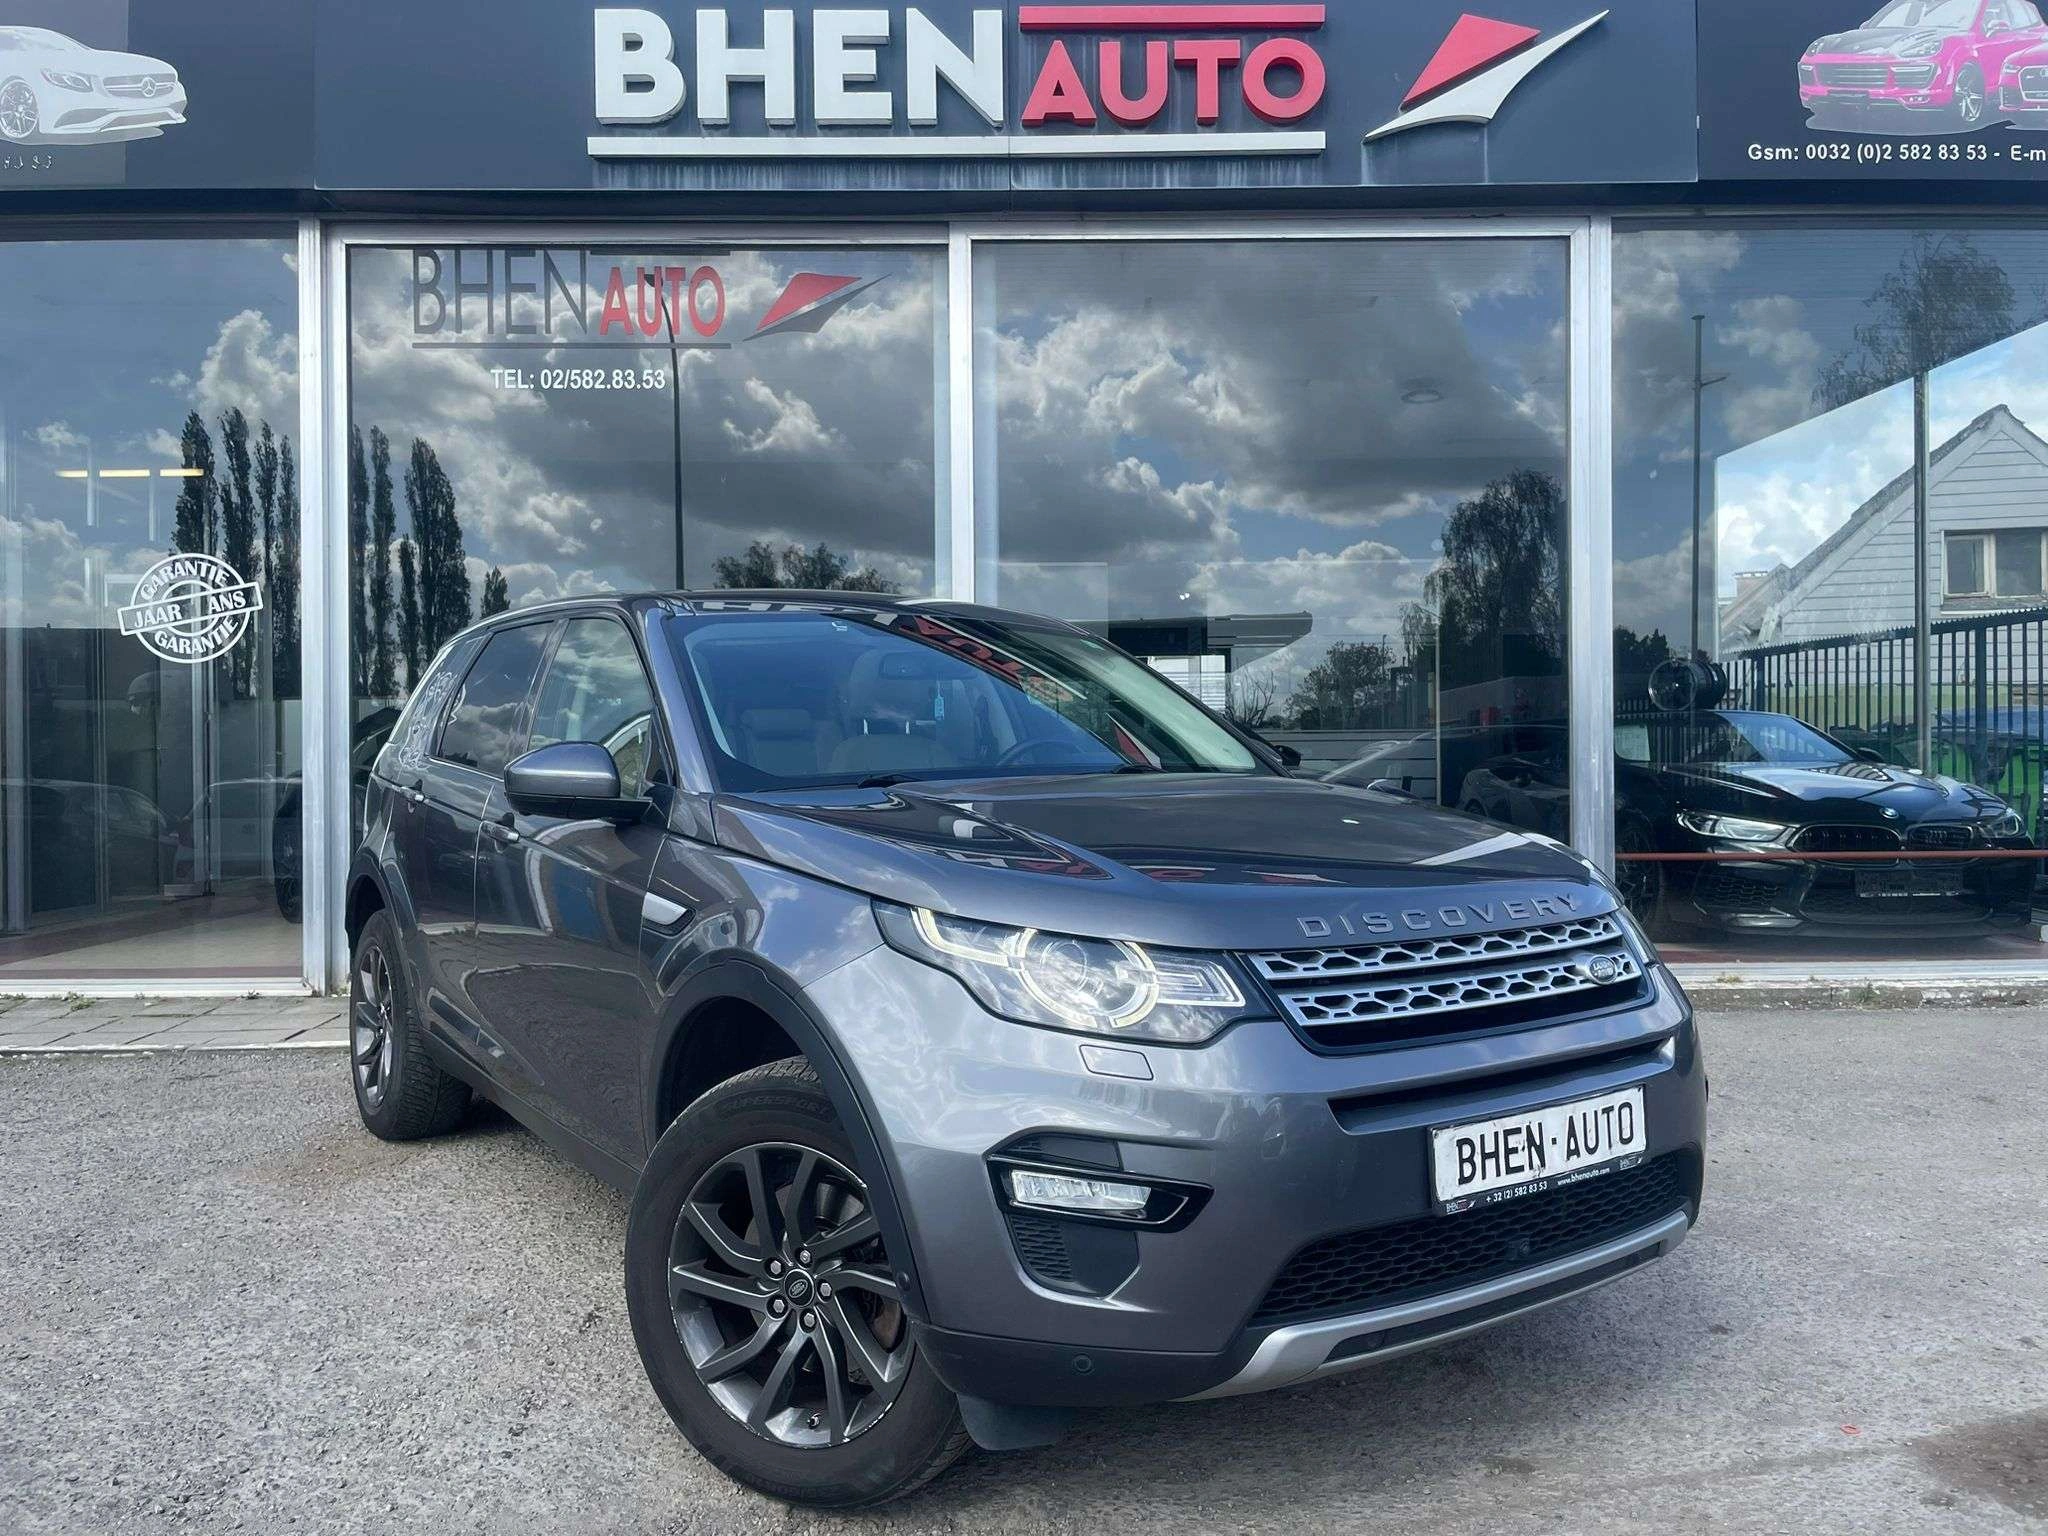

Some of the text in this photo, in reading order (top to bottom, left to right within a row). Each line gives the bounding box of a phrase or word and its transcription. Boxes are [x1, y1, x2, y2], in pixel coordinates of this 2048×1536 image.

[593, 8, 1326, 126] BHEN AUTO
[1747, 143, 1799, 161] Gsm:
[1805, 143, 1851, 160] 0032
[1857, 143, 1893, 164] (0)2
[1899, 144, 1932, 160] 582
[1938, 144, 1960, 161] 83
[1966, 144, 1987, 161] 53
[412, 249, 726, 337] BHEN AUTO
[490, 368, 666, 390] TEL: 02/582.83.53
[140, 560, 230, 600] GARANTIE
[134, 591, 247, 629] JAAR ANS
[154, 615, 239, 654] GARANTIE
[1296, 893, 1577, 938] DISCOVERY
[1455, 1121, 1546, 1186] BHEN
[1565, 1101, 1635, 1161] AUTO
[1514, 1185, 1528, 1197] 582
[1538, 1180, 1548, 1191] 53
